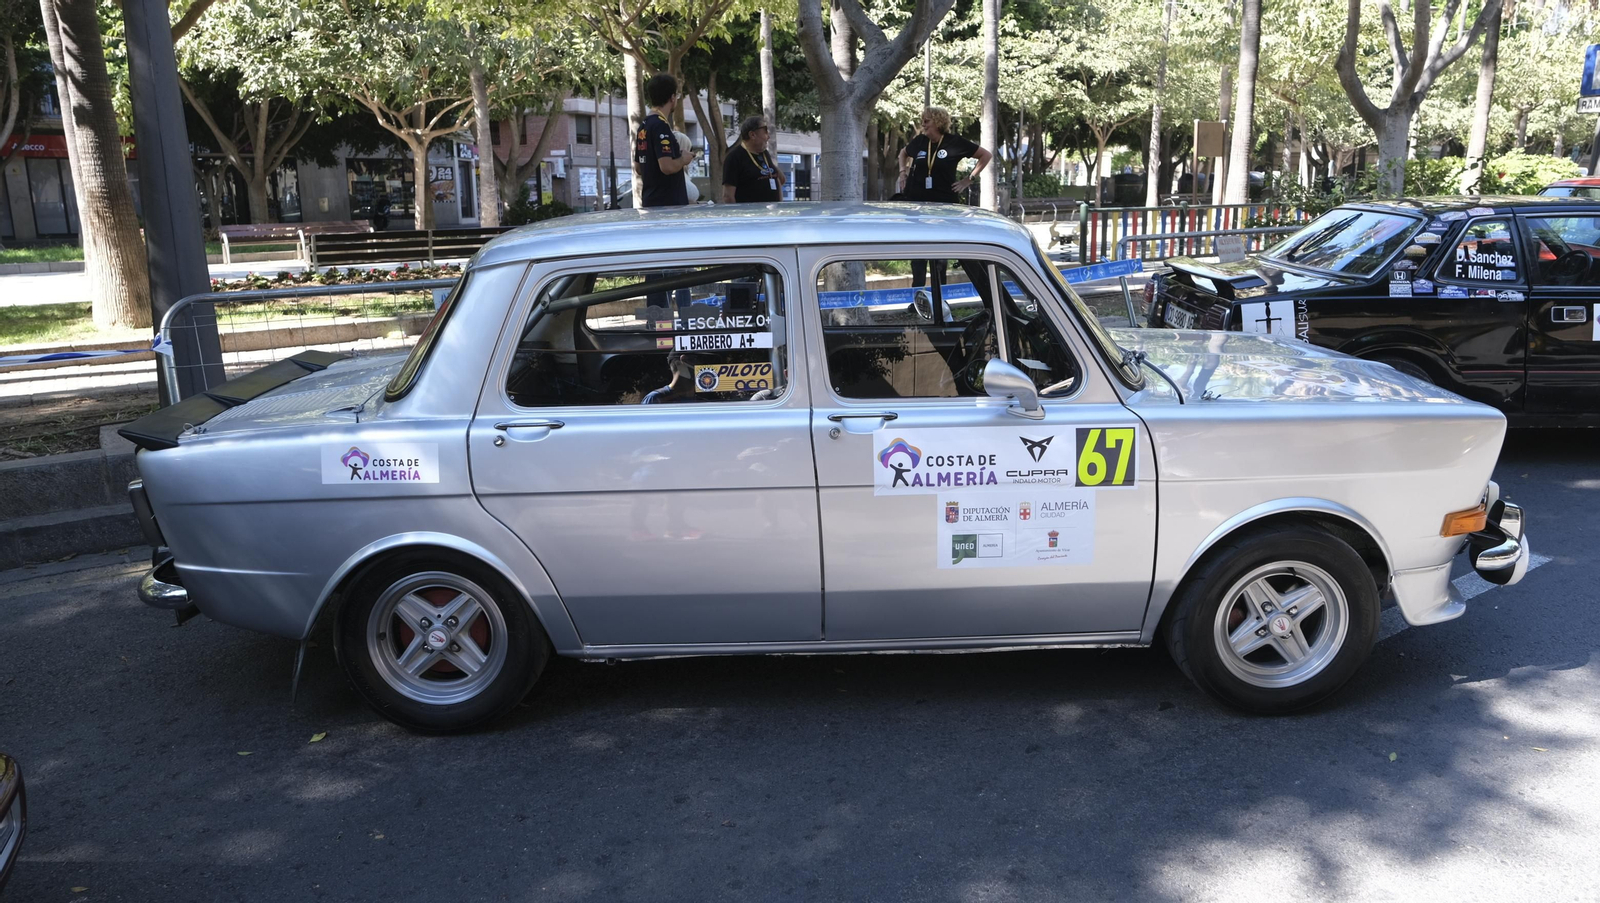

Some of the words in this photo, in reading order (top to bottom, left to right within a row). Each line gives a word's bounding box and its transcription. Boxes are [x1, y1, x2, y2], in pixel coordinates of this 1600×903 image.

[1470, 250, 1513, 264] Sanchez
[1455, 264, 1465, 278] F.
[1468, 264, 1502, 281] Milena
[674, 319, 685, 330] F.
[688, 314, 753, 330] ESCÁNEZ
[680, 336, 687, 350] L.
[690, 334, 732, 349] BARBERO
[740, 333, 754, 348] A+
[718, 363, 772, 377] PILOTO
[372, 458, 404, 467] COSTA
[407, 458, 419, 467] DE
[926, 455, 974, 467] COSTA
[978, 454, 996, 466] DE
[1078, 428, 1134, 486] 67
[363, 467, 421, 481] ALMERÍA
[911, 466, 998, 487] ALMERÍA
[1006, 469, 1068, 477] CUPRA
[963, 506, 1011, 515] DIPUTACIÓN
[1041, 499, 1089, 511] ALMERÍA
[974, 514, 1009, 522] ALMERÍA
